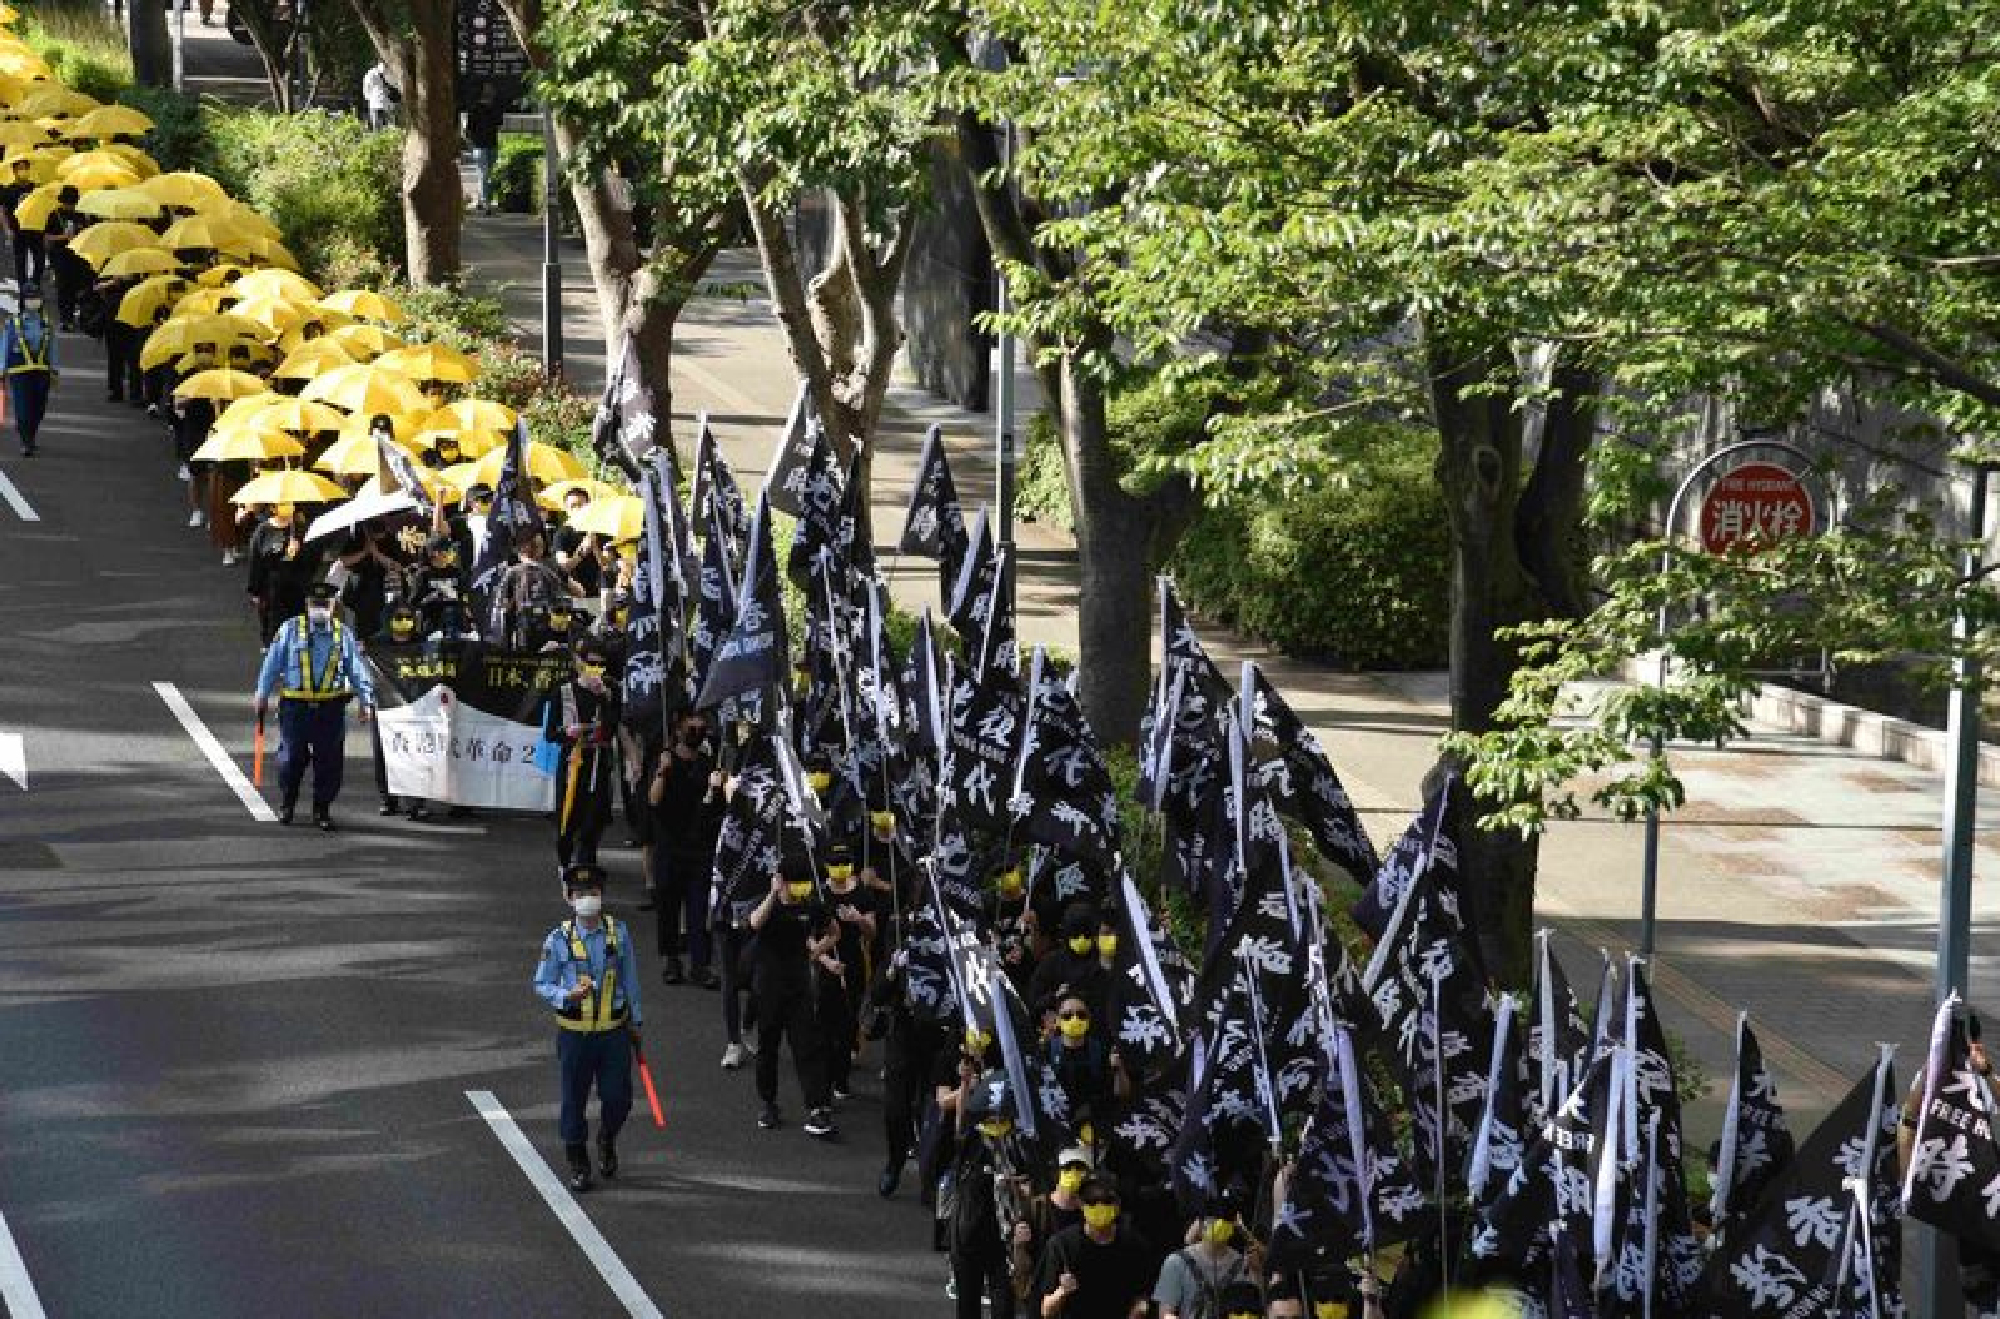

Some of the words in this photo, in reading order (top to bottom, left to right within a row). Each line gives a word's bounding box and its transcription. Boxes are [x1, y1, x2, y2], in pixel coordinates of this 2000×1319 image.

[1711, 499, 1804, 542] 消火栓
[1930, 1097, 1969, 1129] FREE
